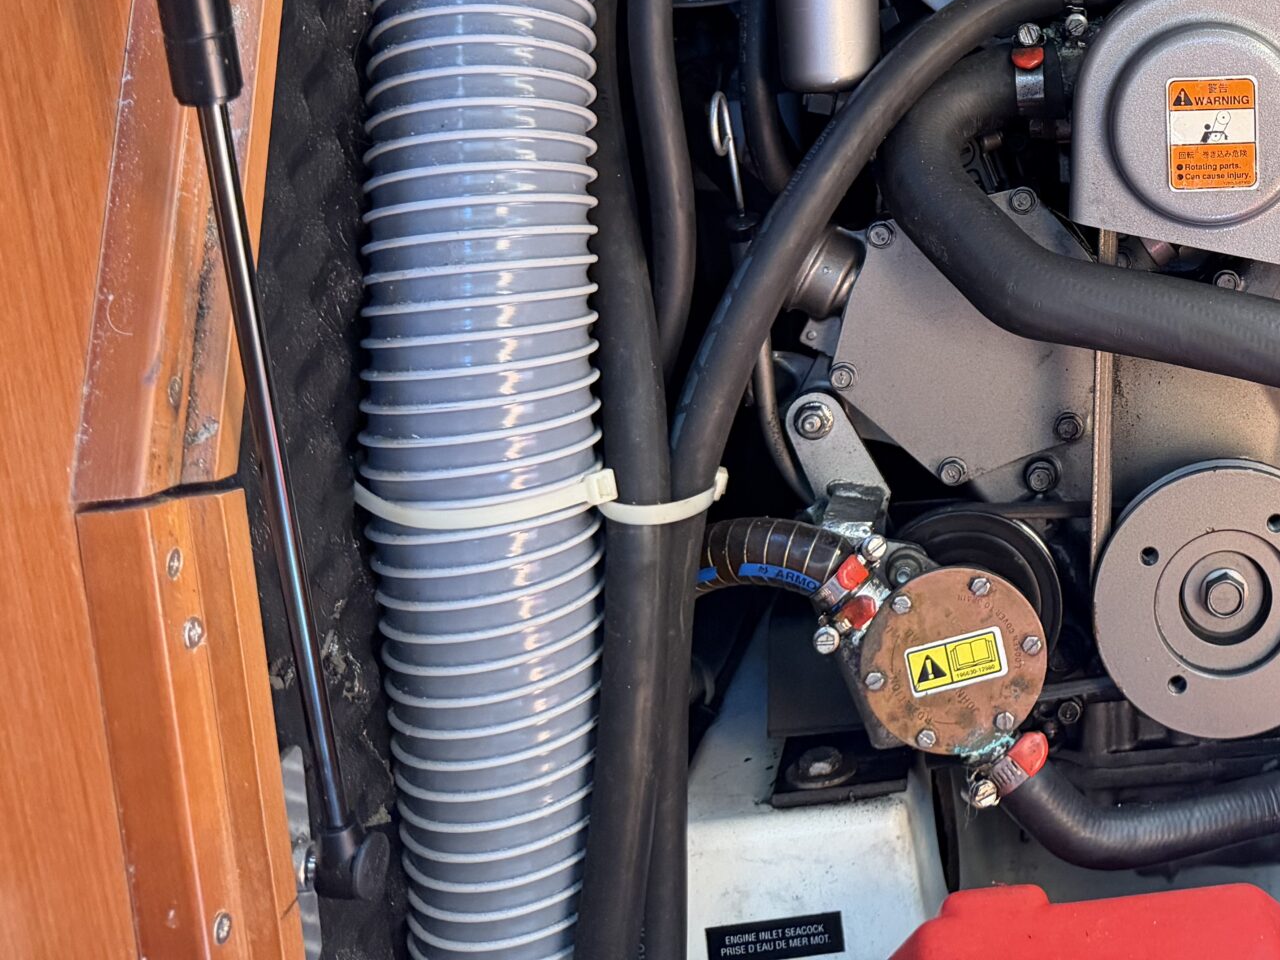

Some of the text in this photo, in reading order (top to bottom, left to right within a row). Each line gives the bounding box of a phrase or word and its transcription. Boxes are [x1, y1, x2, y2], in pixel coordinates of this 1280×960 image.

[1194, 95, 1250, 106] WARNING
[1185, 163, 1243, 172] Rotating parts.
[1202, 173, 1225, 181] cause
[1227, 172, 1252, 181] injury.
[725, 924, 825, 945] ENGINE INLET SEACOCK
[720, 945, 746, 957] PRISE
[776, 940, 788, 949] DE
[789, 937, 809, 947] MER
[811, 934, 832, 944] MOT.
